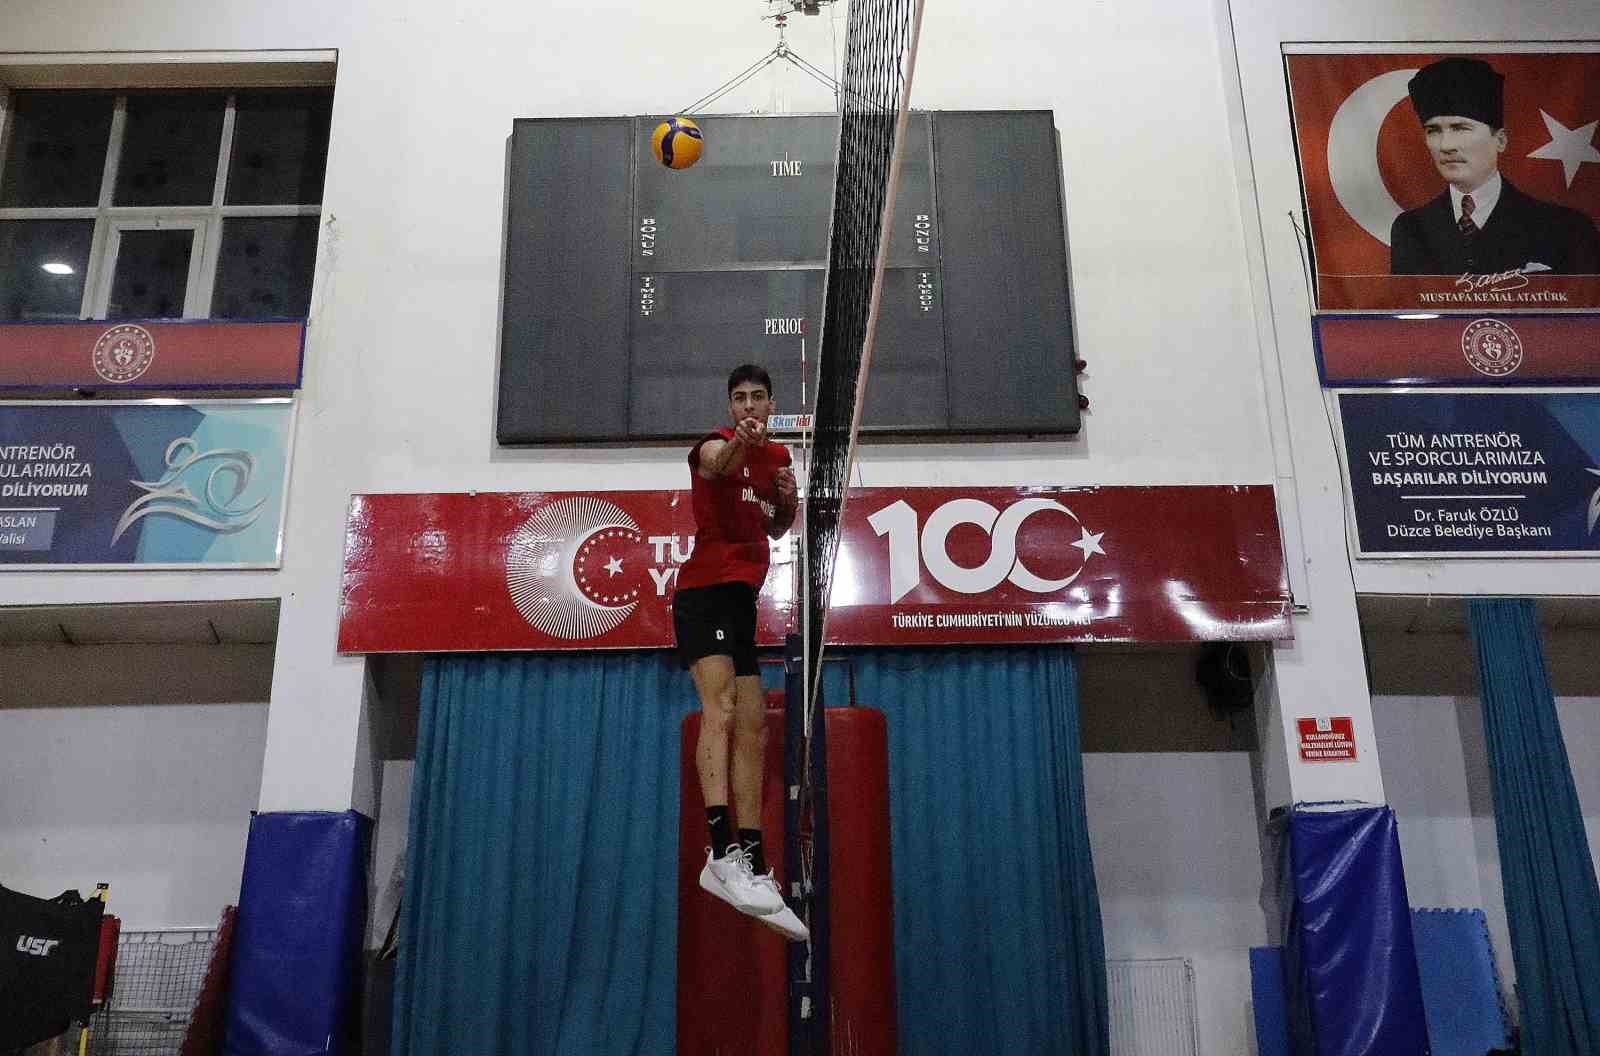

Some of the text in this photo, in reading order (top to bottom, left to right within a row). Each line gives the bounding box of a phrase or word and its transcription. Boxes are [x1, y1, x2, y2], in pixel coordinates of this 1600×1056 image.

[771, 160, 802, 176] TIME
[640, 218, 657, 256] BONUS
[914, 214, 931, 253] BONUS
[1419, 290, 1569, 302] MUSTAFA KEMAL ATATÜRK
[1386, 431, 1522, 449] TÜM ANTRENÖR
[1369, 451, 1546, 466] VE SPORCULARIMIZA
[1372, 470, 1548, 488] BAŞARILAR DİLİYORUM
[2, 481, 89, 497] DİLİYORUM
[1414, 506, 1519, 522] Dr. Faruk ÖZLÜ
[1387, 523, 1552, 540] Düzce Belediye Başkanı
[866, 498, 1083, 605] 100
[892, 610, 934, 628] TÜRKİYE
[936, 610, 1023, 627] CUMHURİYETİ'NİN
